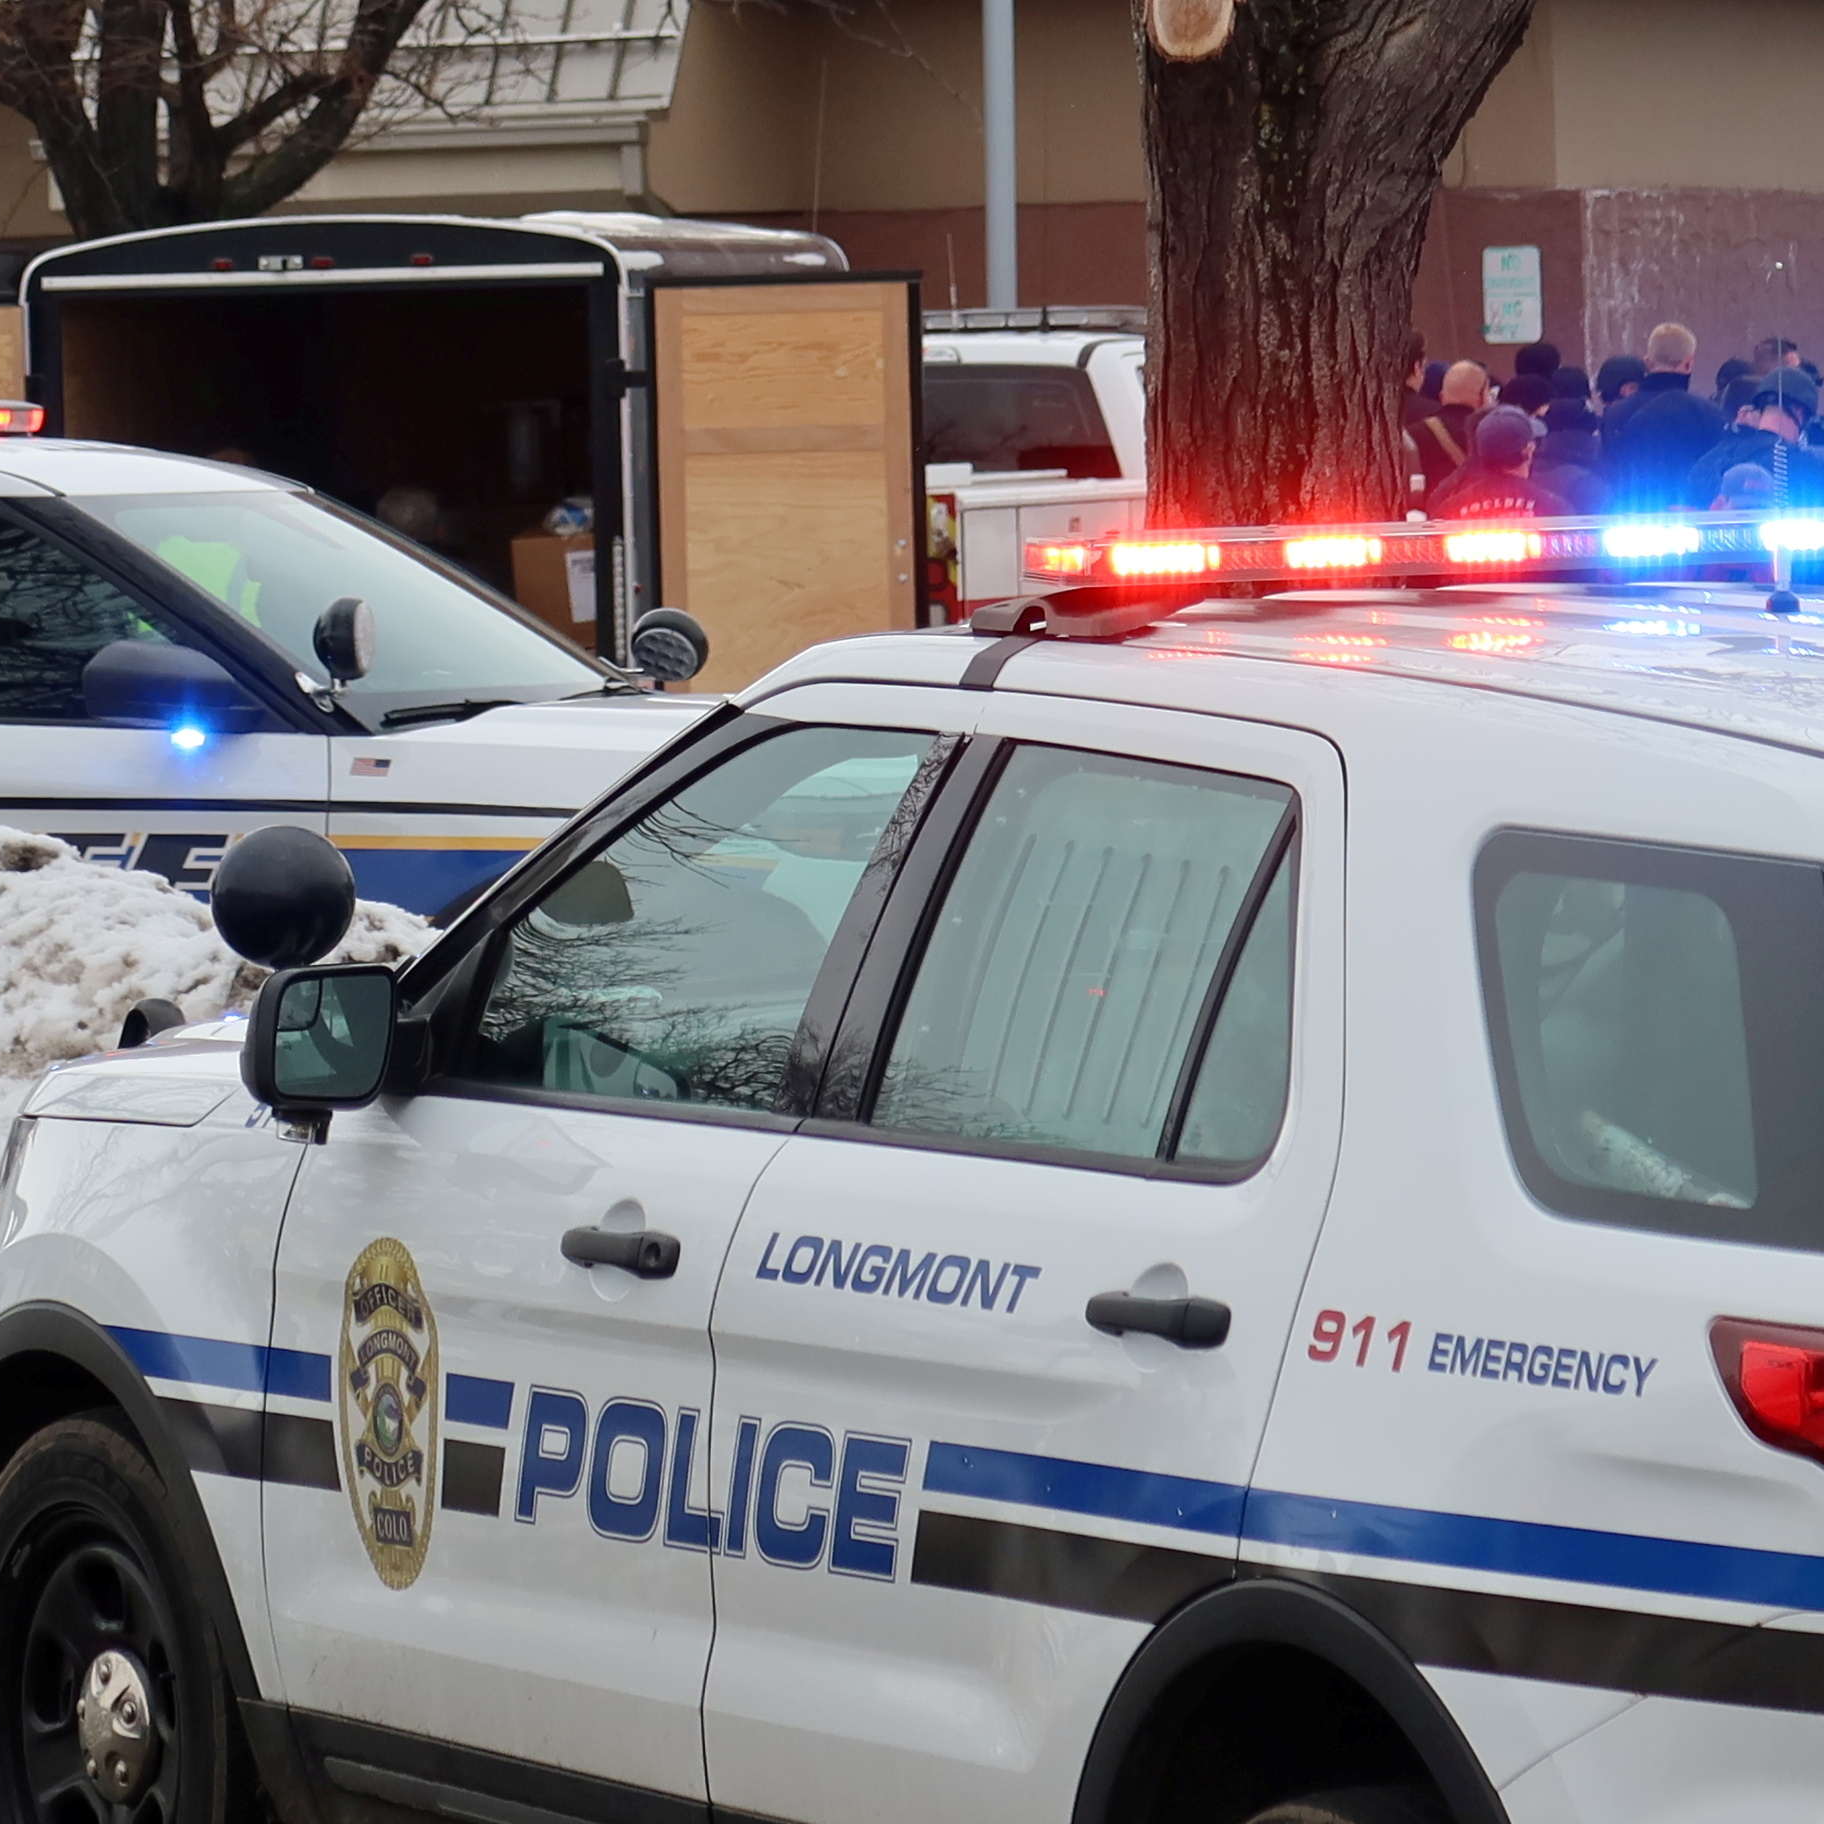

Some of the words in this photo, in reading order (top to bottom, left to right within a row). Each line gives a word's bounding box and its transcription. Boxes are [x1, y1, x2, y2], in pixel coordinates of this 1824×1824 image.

[755, 1231, 1043, 1314] LONGMONT
[359, 1288, 417, 1325] OFFICER
[359, 1332, 417, 1369] LONGMONT
[1306, 1309, 1413, 1373] 911
[1427, 1332, 1659, 1398] EMERGENCY
[363, 1451, 416, 1487] POLICE
[513, 1382, 913, 1583] POLICE
